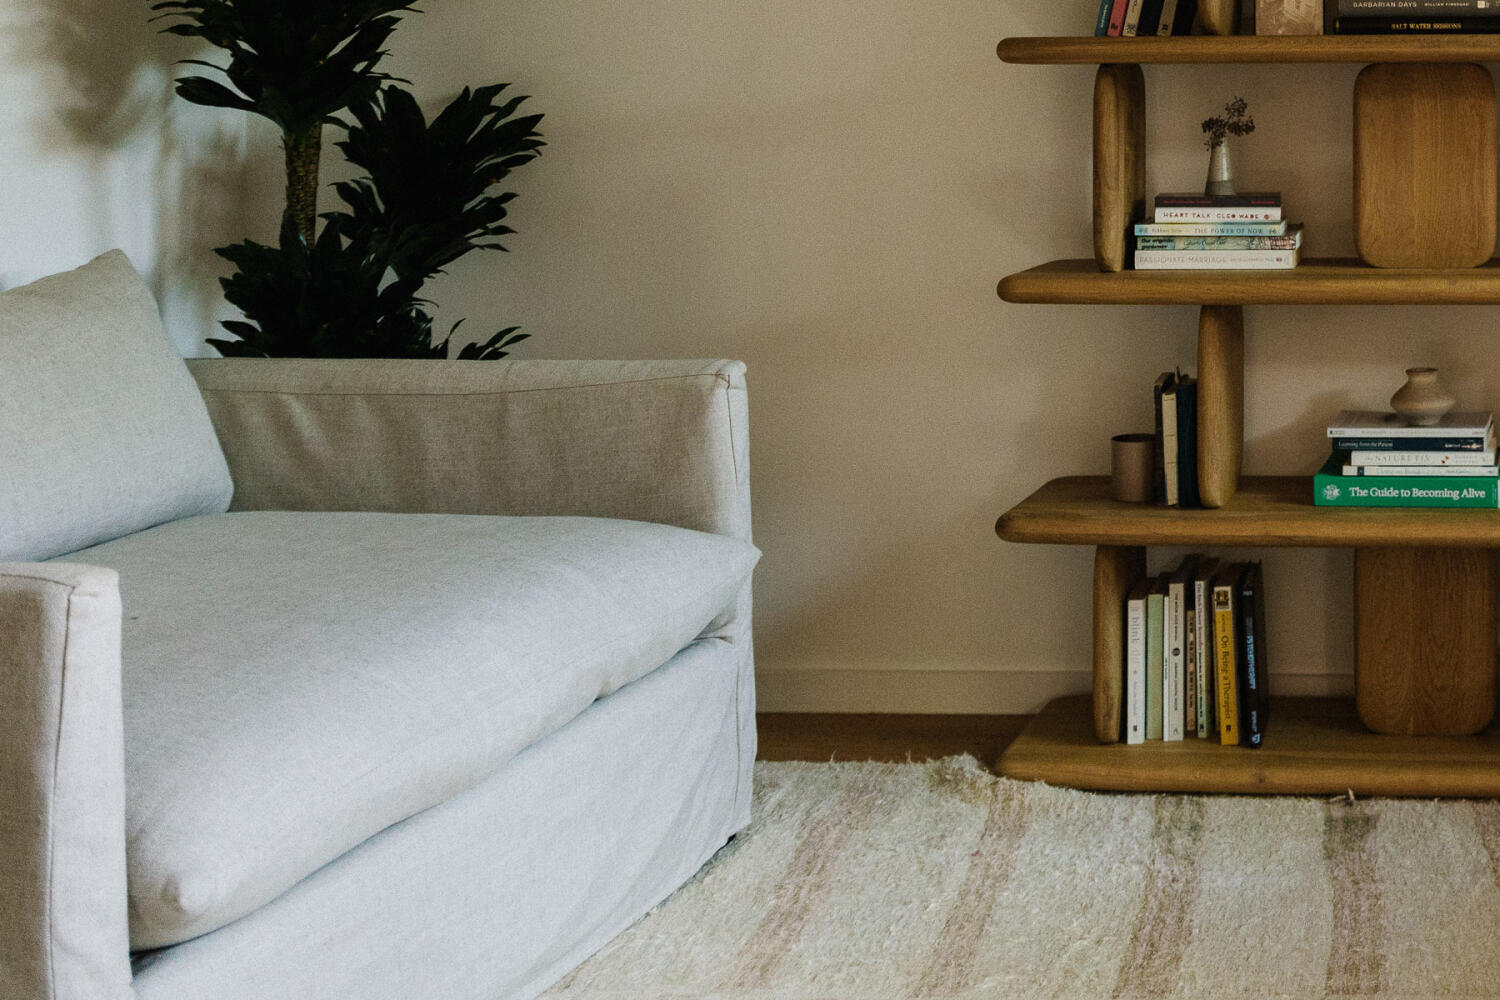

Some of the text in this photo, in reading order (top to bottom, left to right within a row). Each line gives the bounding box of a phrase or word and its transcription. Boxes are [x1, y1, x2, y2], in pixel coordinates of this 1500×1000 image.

[1349, 487, 1368, 498] The
[1369, 487, 1399, 498] Guide
[1400, 488, 1410, 498] to
[1411, 487, 1460, 500] Becoming
[1461, 487, 1486, 498] Alive
[1131, 616, 1140, 644] blink
[1221, 635, 1229, 648] On
[1221, 651, 1230, 675] Being
[1222, 680, 1232, 719] Therapist
